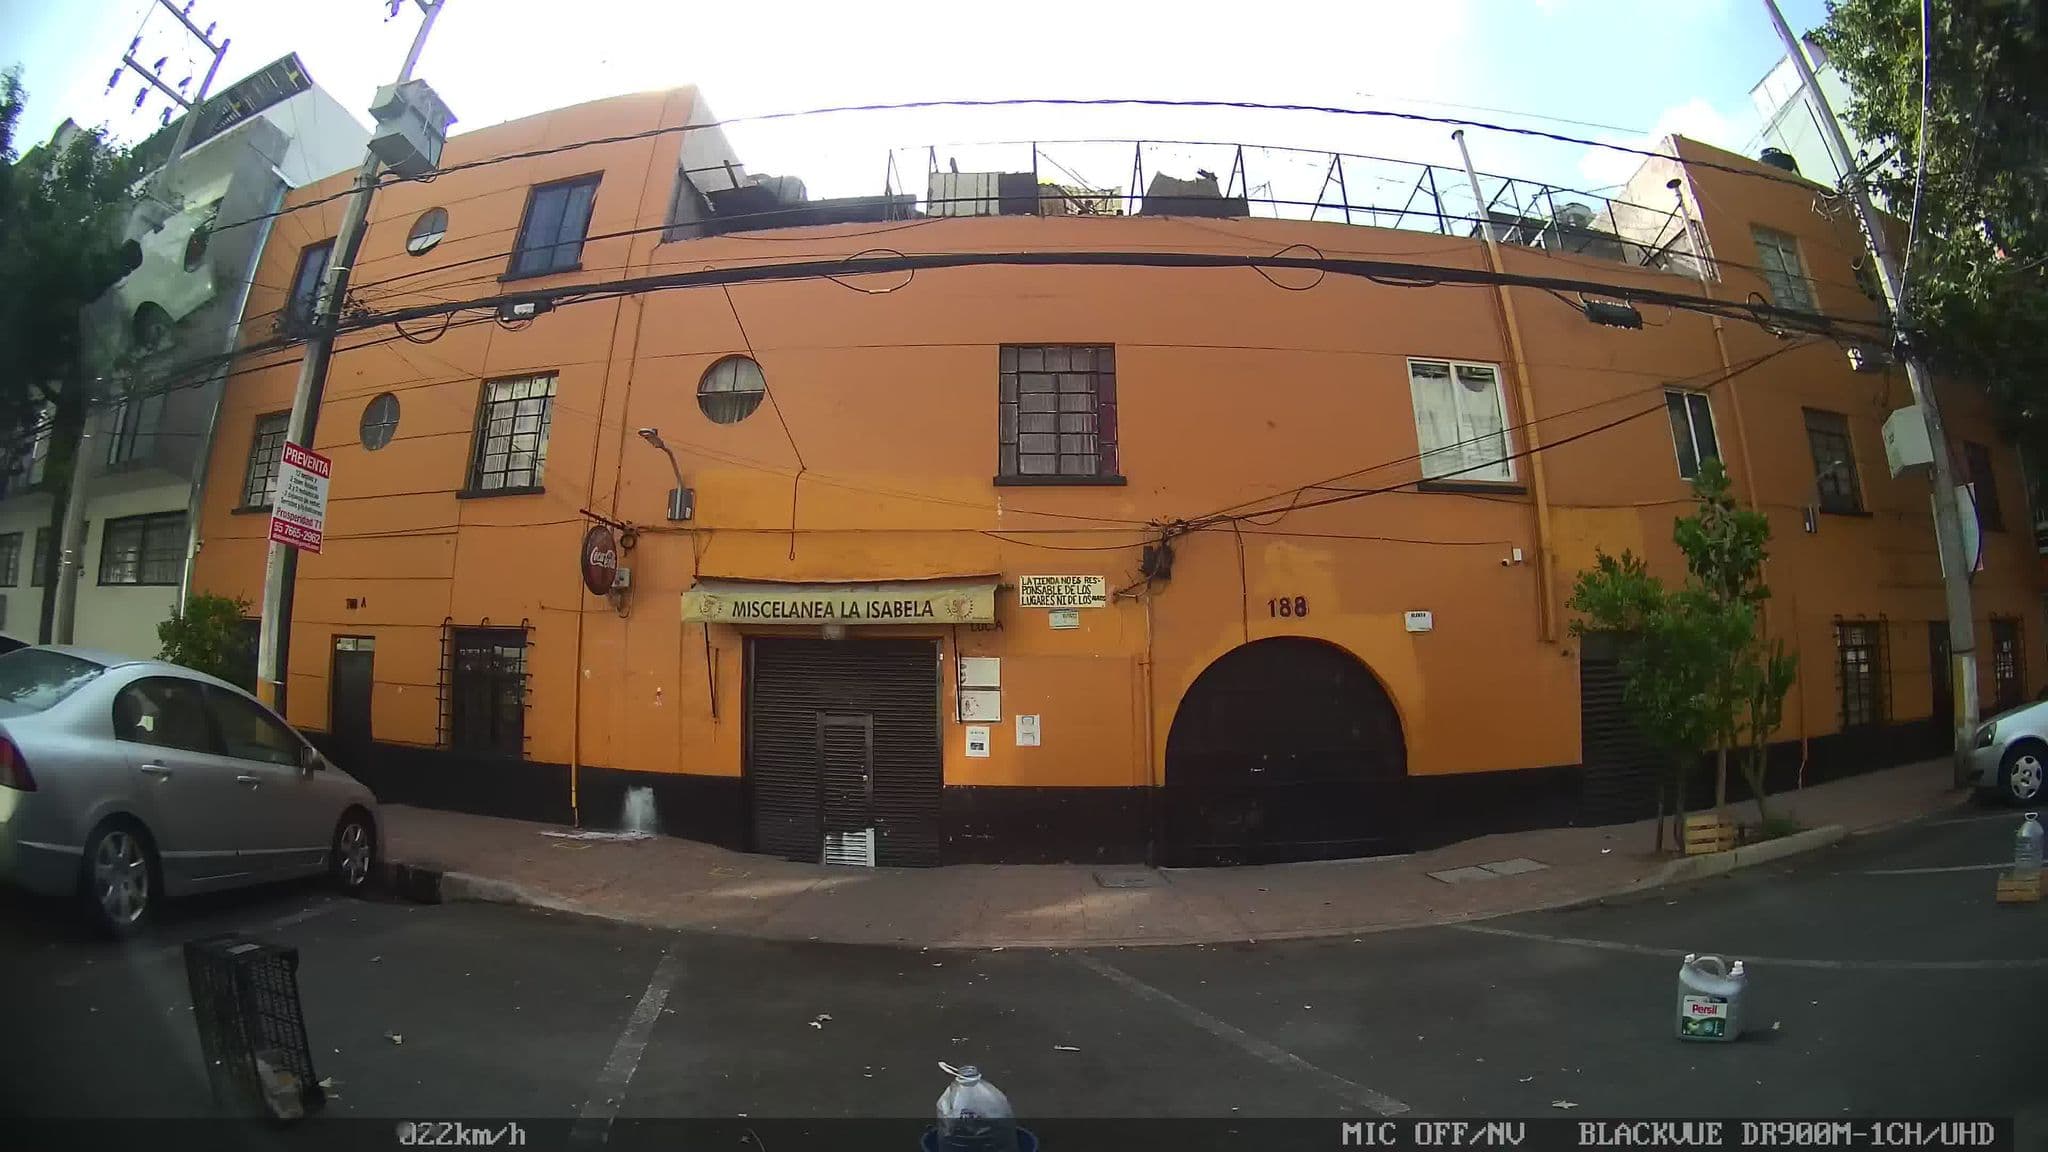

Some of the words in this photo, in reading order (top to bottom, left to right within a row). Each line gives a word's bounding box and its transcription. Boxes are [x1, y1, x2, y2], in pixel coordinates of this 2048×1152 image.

[285, 446, 329, 476] PREVENTA
[276, 507, 313, 527] Prosperidad
[273, 521, 284, 533] 55
[1021, 585, 1063, 595] PONSABLE
[1065, 585, 1075, 595] DE
[1077, 585, 1092, 594] LOS
[1021, 595, 1055, 606] LUGARES
[1056, 596, 1067, 605] NI
[1068, 595, 1077, 605] DE
[1078, 595, 1092, 605] LOS
[1267, 596, 1308, 618] 188
[732, 600, 835, 619] MISCELANEA
[841, 601, 861, 619] LA
[866, 600, 934, 619] ISABELA
[1692, 1004, 1718, 1015] Persil
